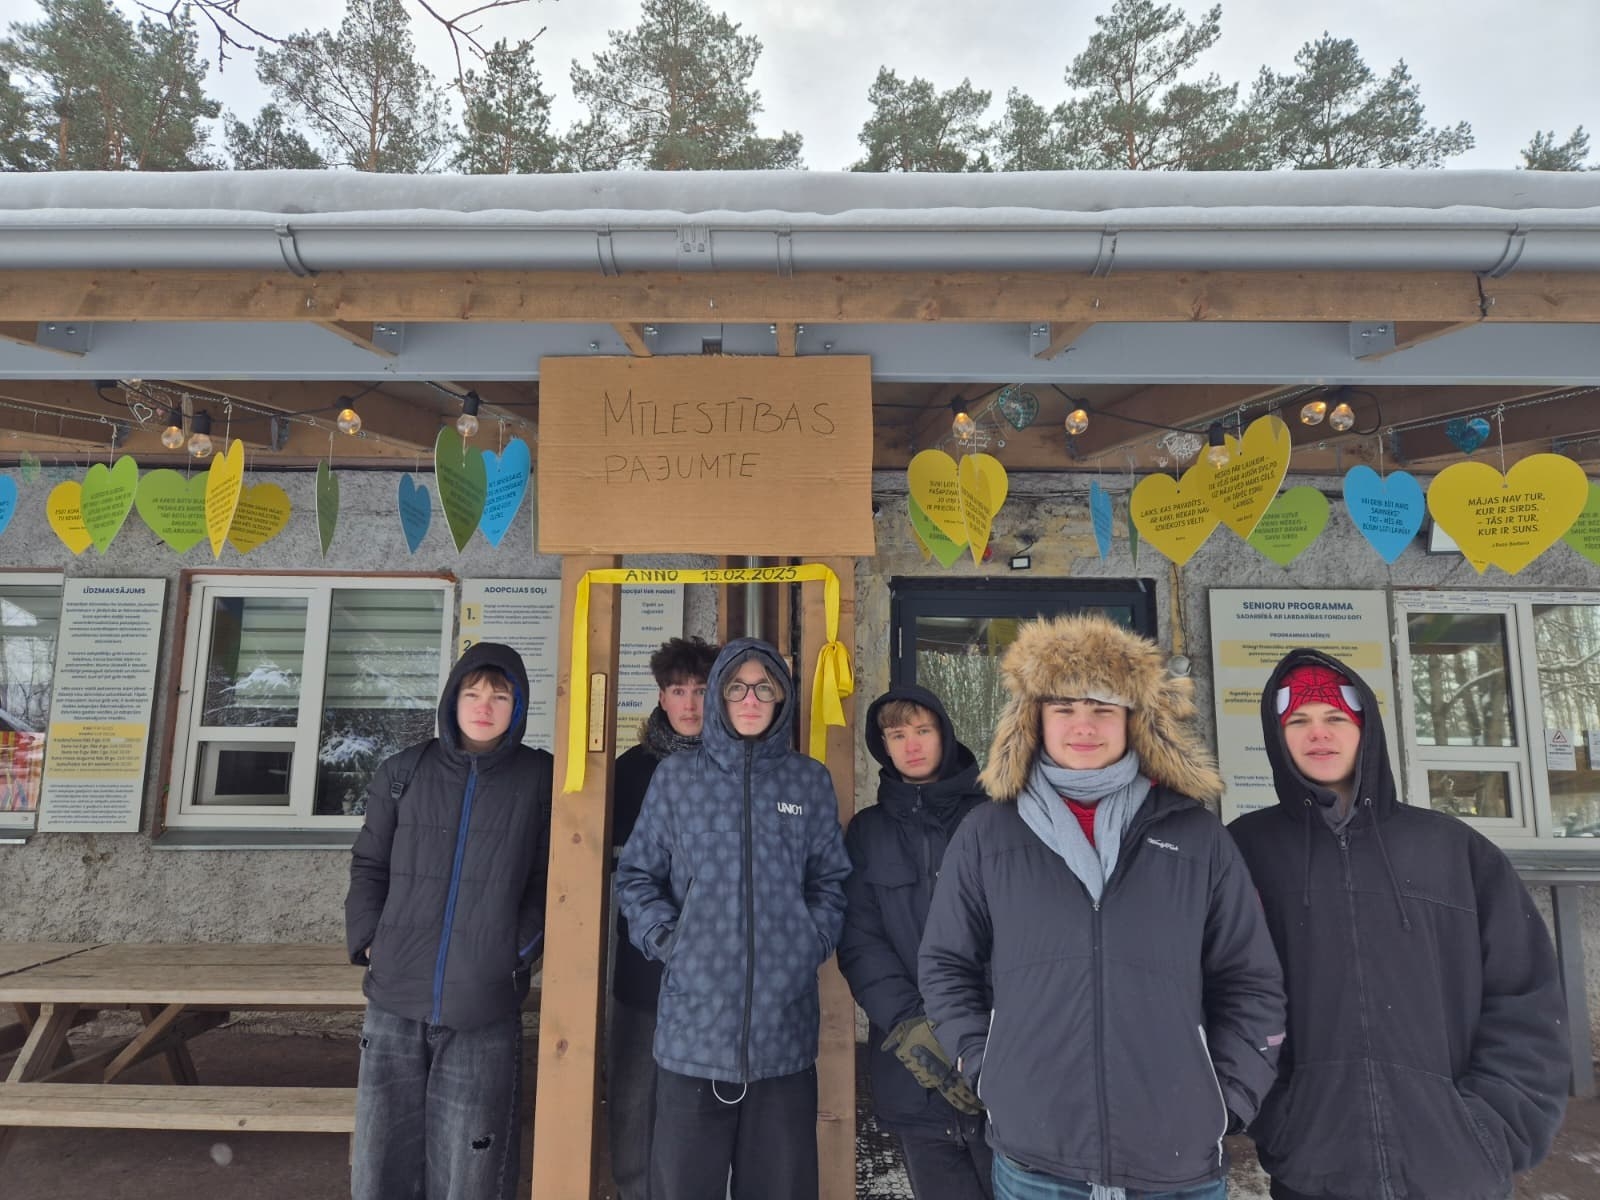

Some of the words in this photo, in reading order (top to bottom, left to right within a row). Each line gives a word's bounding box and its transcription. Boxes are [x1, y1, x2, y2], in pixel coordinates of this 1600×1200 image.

[605, 453, 761, 484] PAJUMTE
[1468, 496, 1499, 506] MĀJAS
[1502, 494, 1522, 504] NAV
[1475, 507, 1495, 516] KUR
[1497, 506, 1507, 514] IR
[1486, 515, 1503, 525] TĀS
[1505, 515, 1514, 524] IR
[1478, 527, 1498, 536] KUR
[1500, 526, 1510, 534] IR
[625, 569, 679, 582] ANNO
[702, 567, 797, 582] 15.02.2025
[83, 585, 146, 594] LĪDZMAKSĀJUMS
[484, 586, 529, 594] ADOPCIJAS
[530, 587, 547, 595] SOĻI
[1242, 601, 1286, 610] SENIORU
[1287, 602, 1354, 611] PROGRAMMA
[467, 607, 476, 620] 1.
